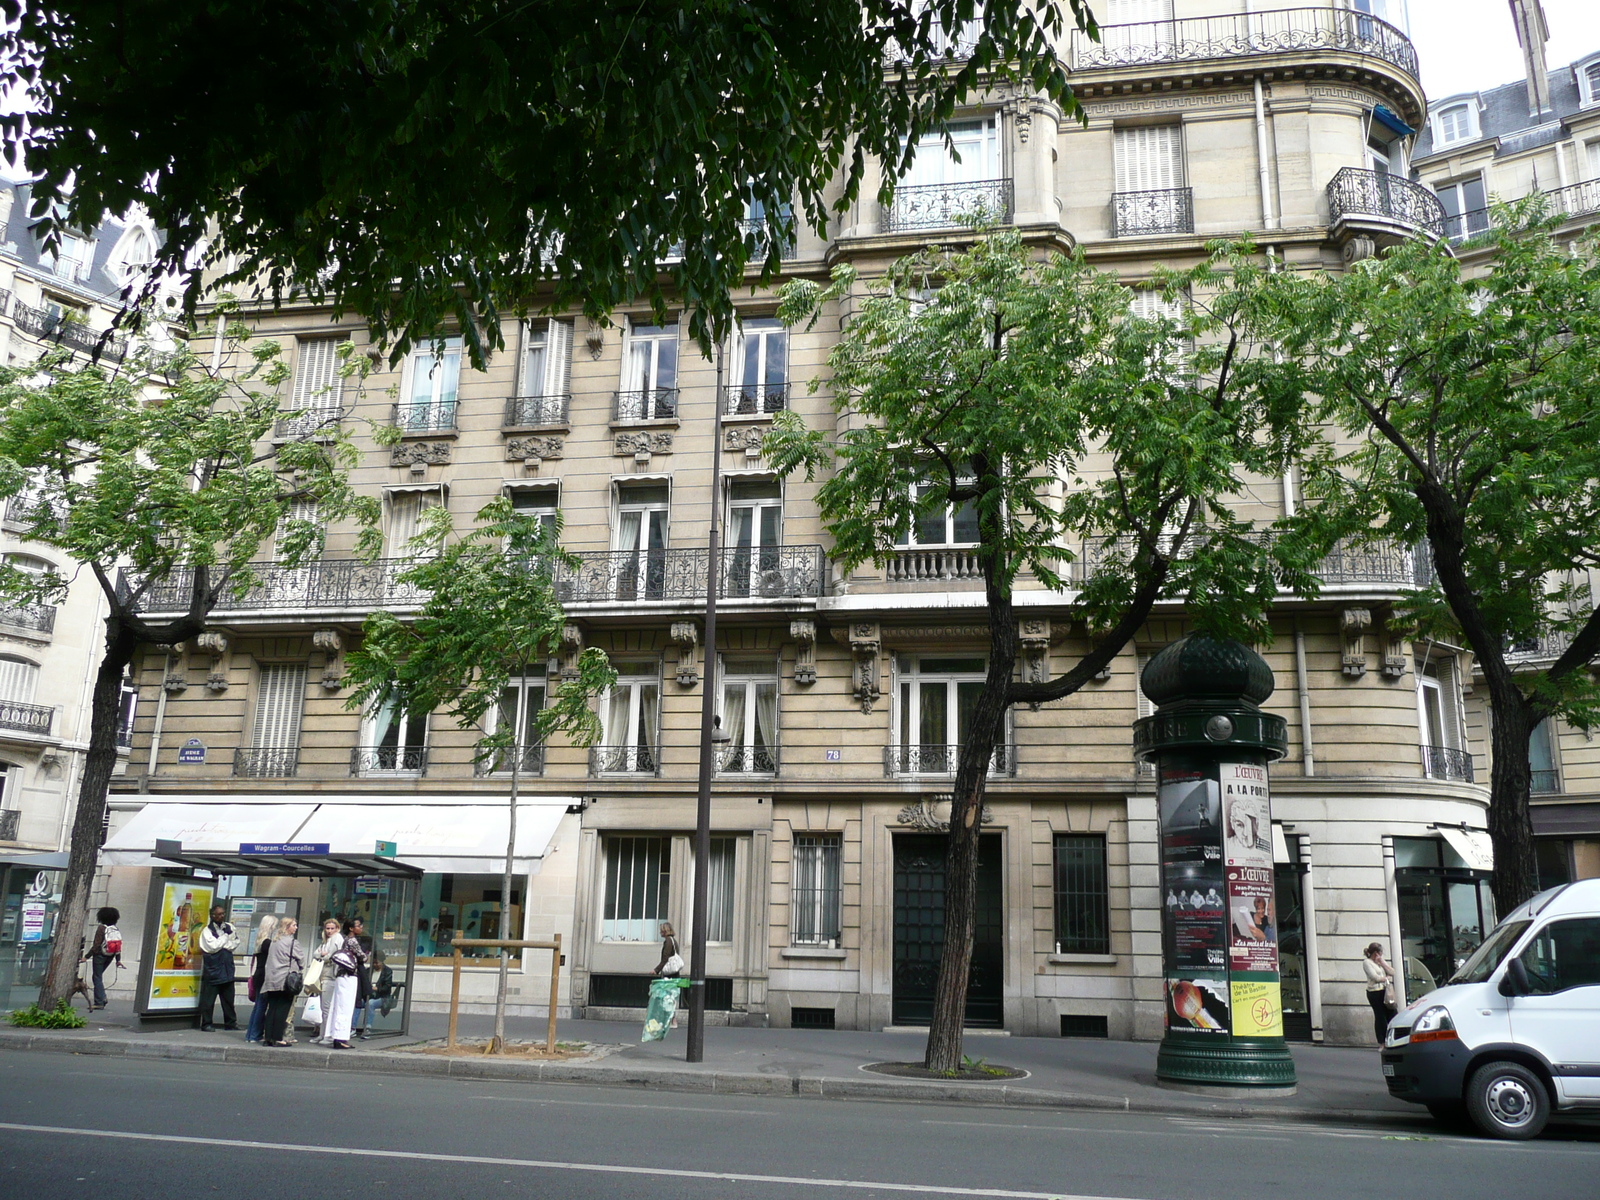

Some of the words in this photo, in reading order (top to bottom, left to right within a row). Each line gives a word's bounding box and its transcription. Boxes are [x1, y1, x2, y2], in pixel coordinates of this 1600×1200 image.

[827, 750, 839, 760] 78
[1227, 784, 1233, 795] A
[254, 844, 279, 852] Wagram
[282, 844, 315, 852] Courcelles
